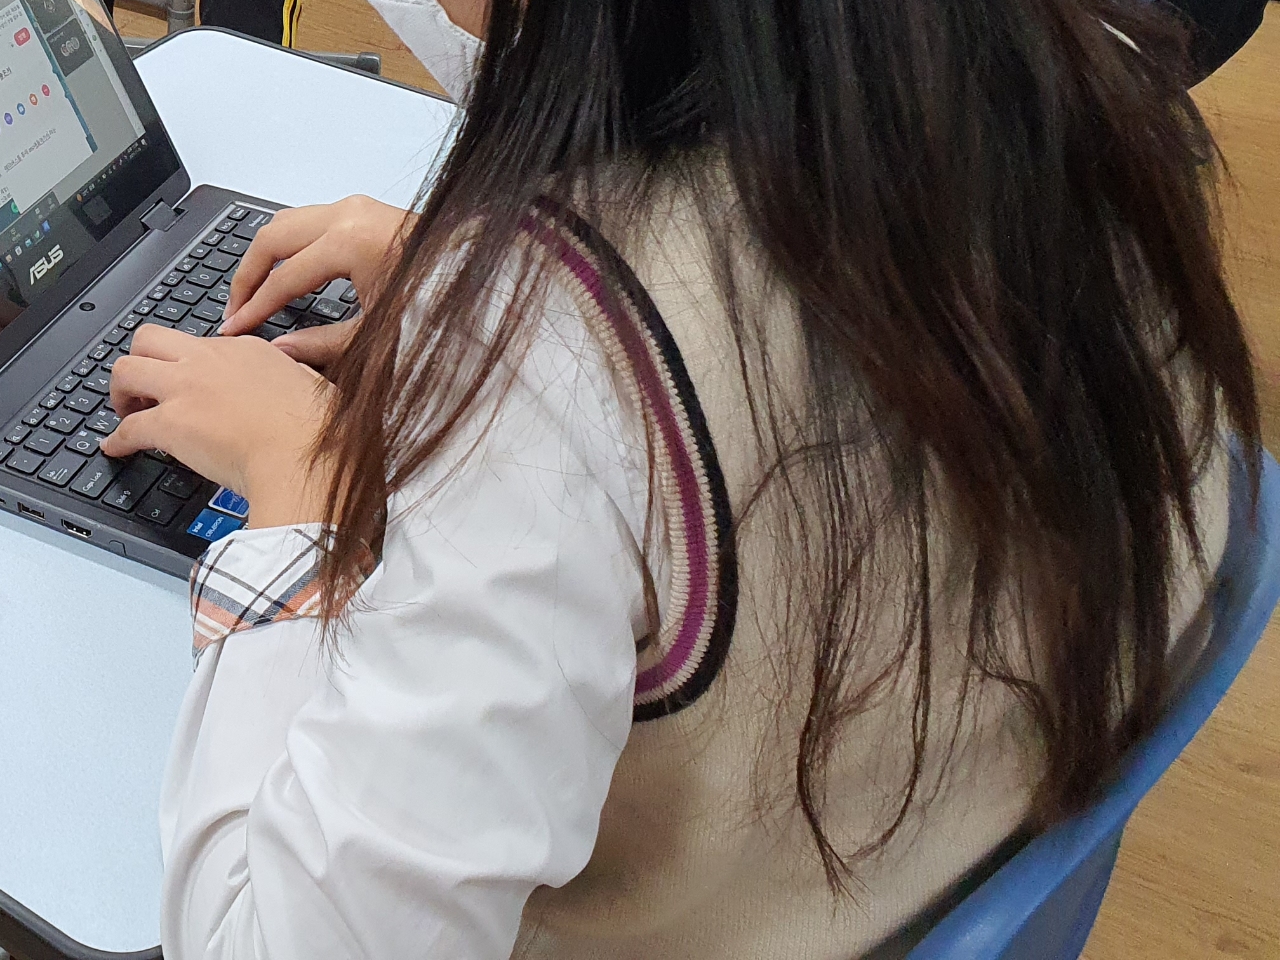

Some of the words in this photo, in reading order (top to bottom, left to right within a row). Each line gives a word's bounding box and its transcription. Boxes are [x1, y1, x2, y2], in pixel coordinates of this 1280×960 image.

[29, 244, 64, 286] ASUS
[93, 418, 110, 431] W
[76, 440, 91, 451] Q
